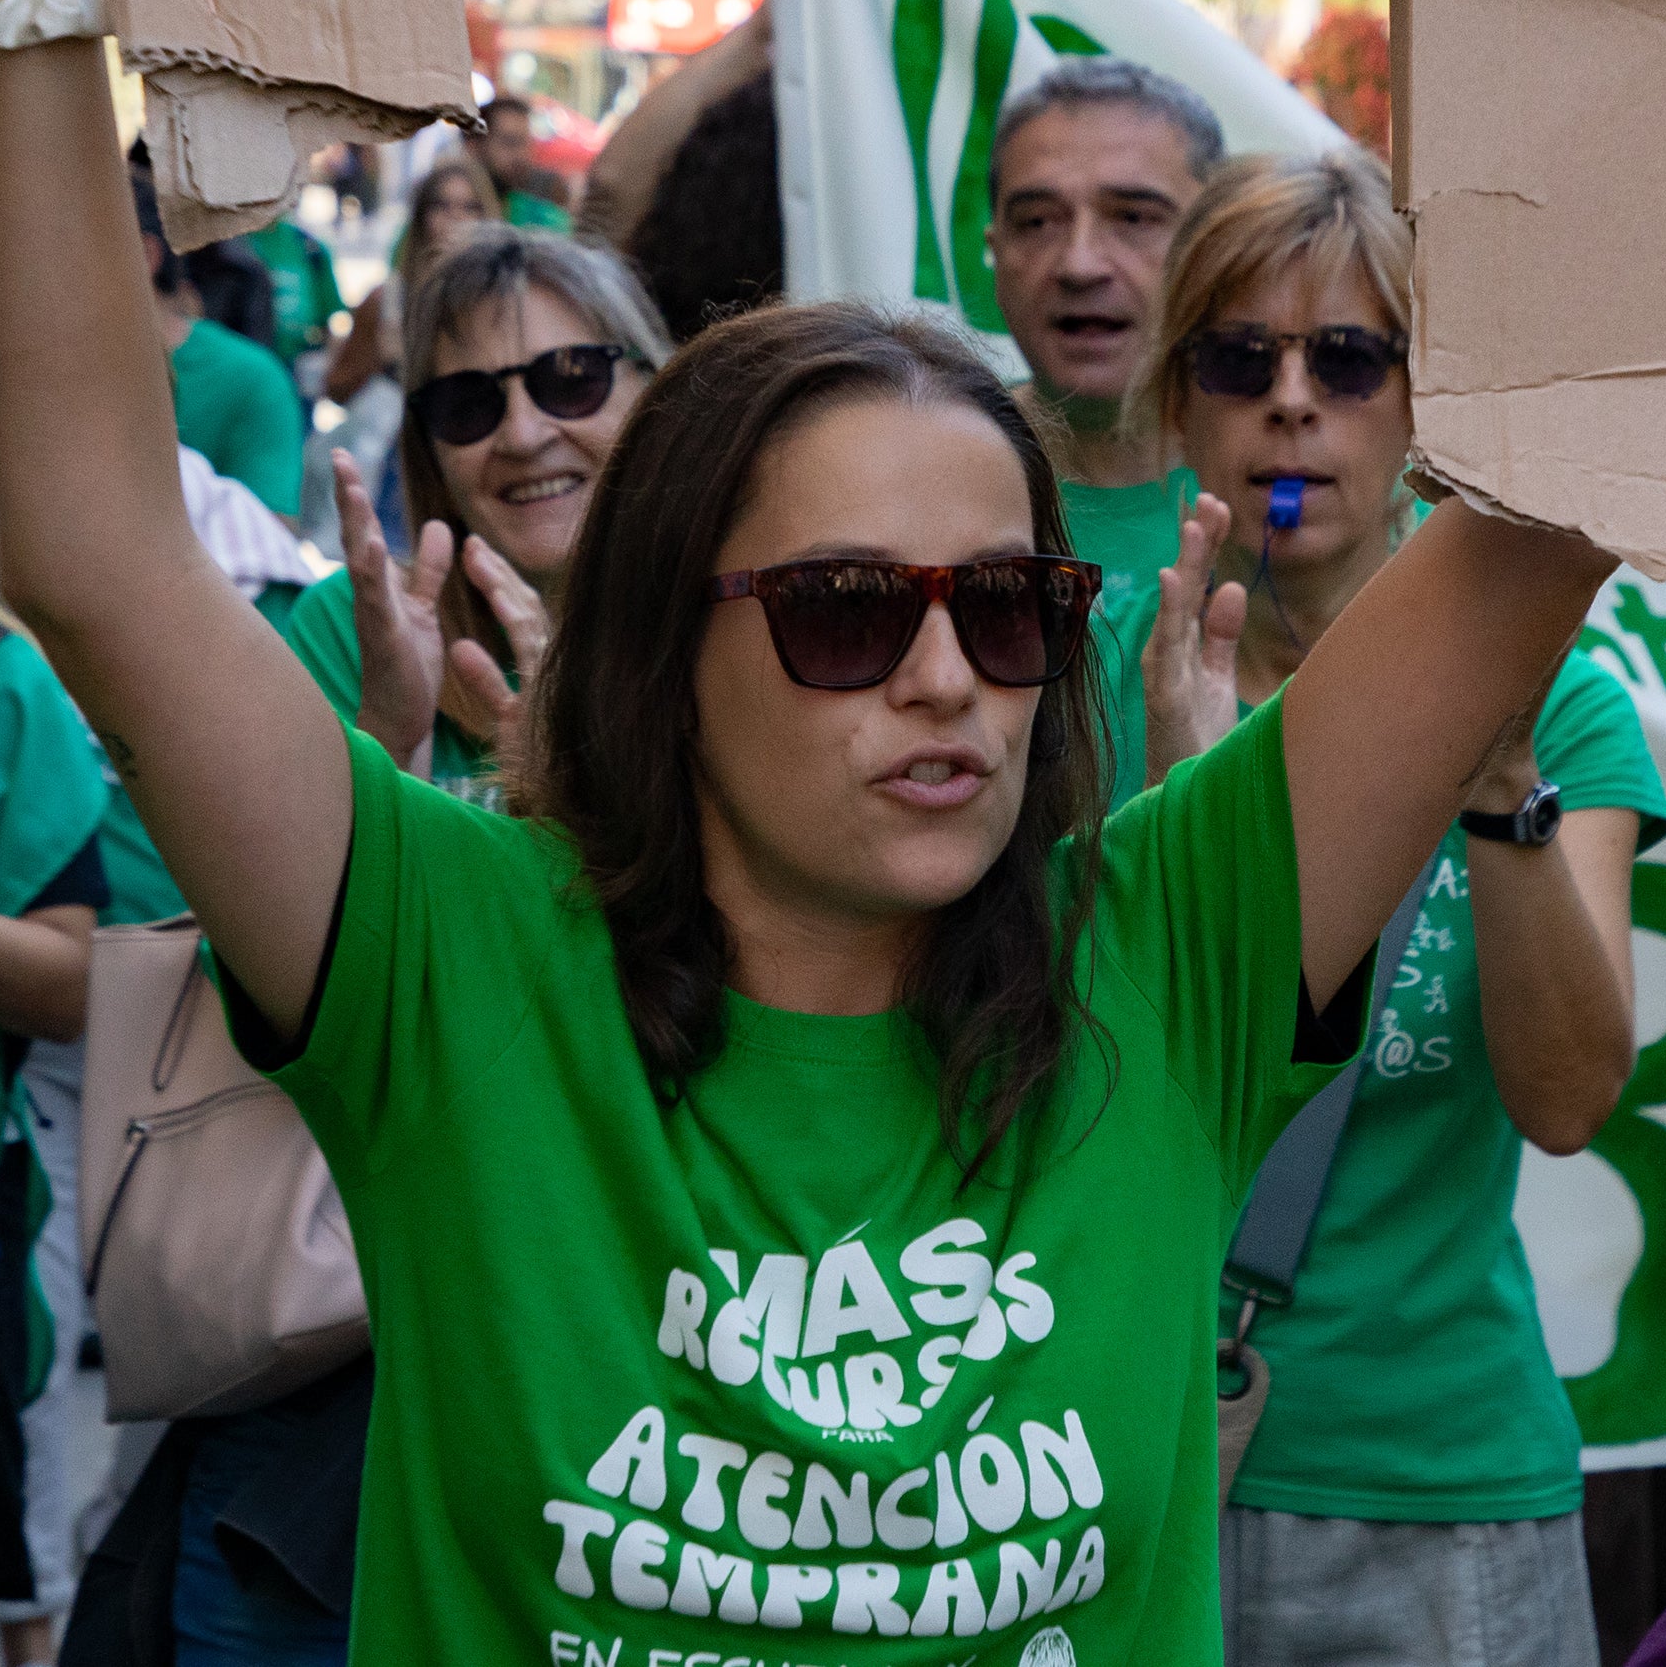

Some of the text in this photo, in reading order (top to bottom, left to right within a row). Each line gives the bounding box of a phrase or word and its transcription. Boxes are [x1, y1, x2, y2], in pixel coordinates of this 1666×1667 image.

[708, 1218, 993, 1360] MÁS
[586, 1396, 1104, 1551] ATENCIÓN
[543, 1500, 1105, 1636] TEMPRANA
